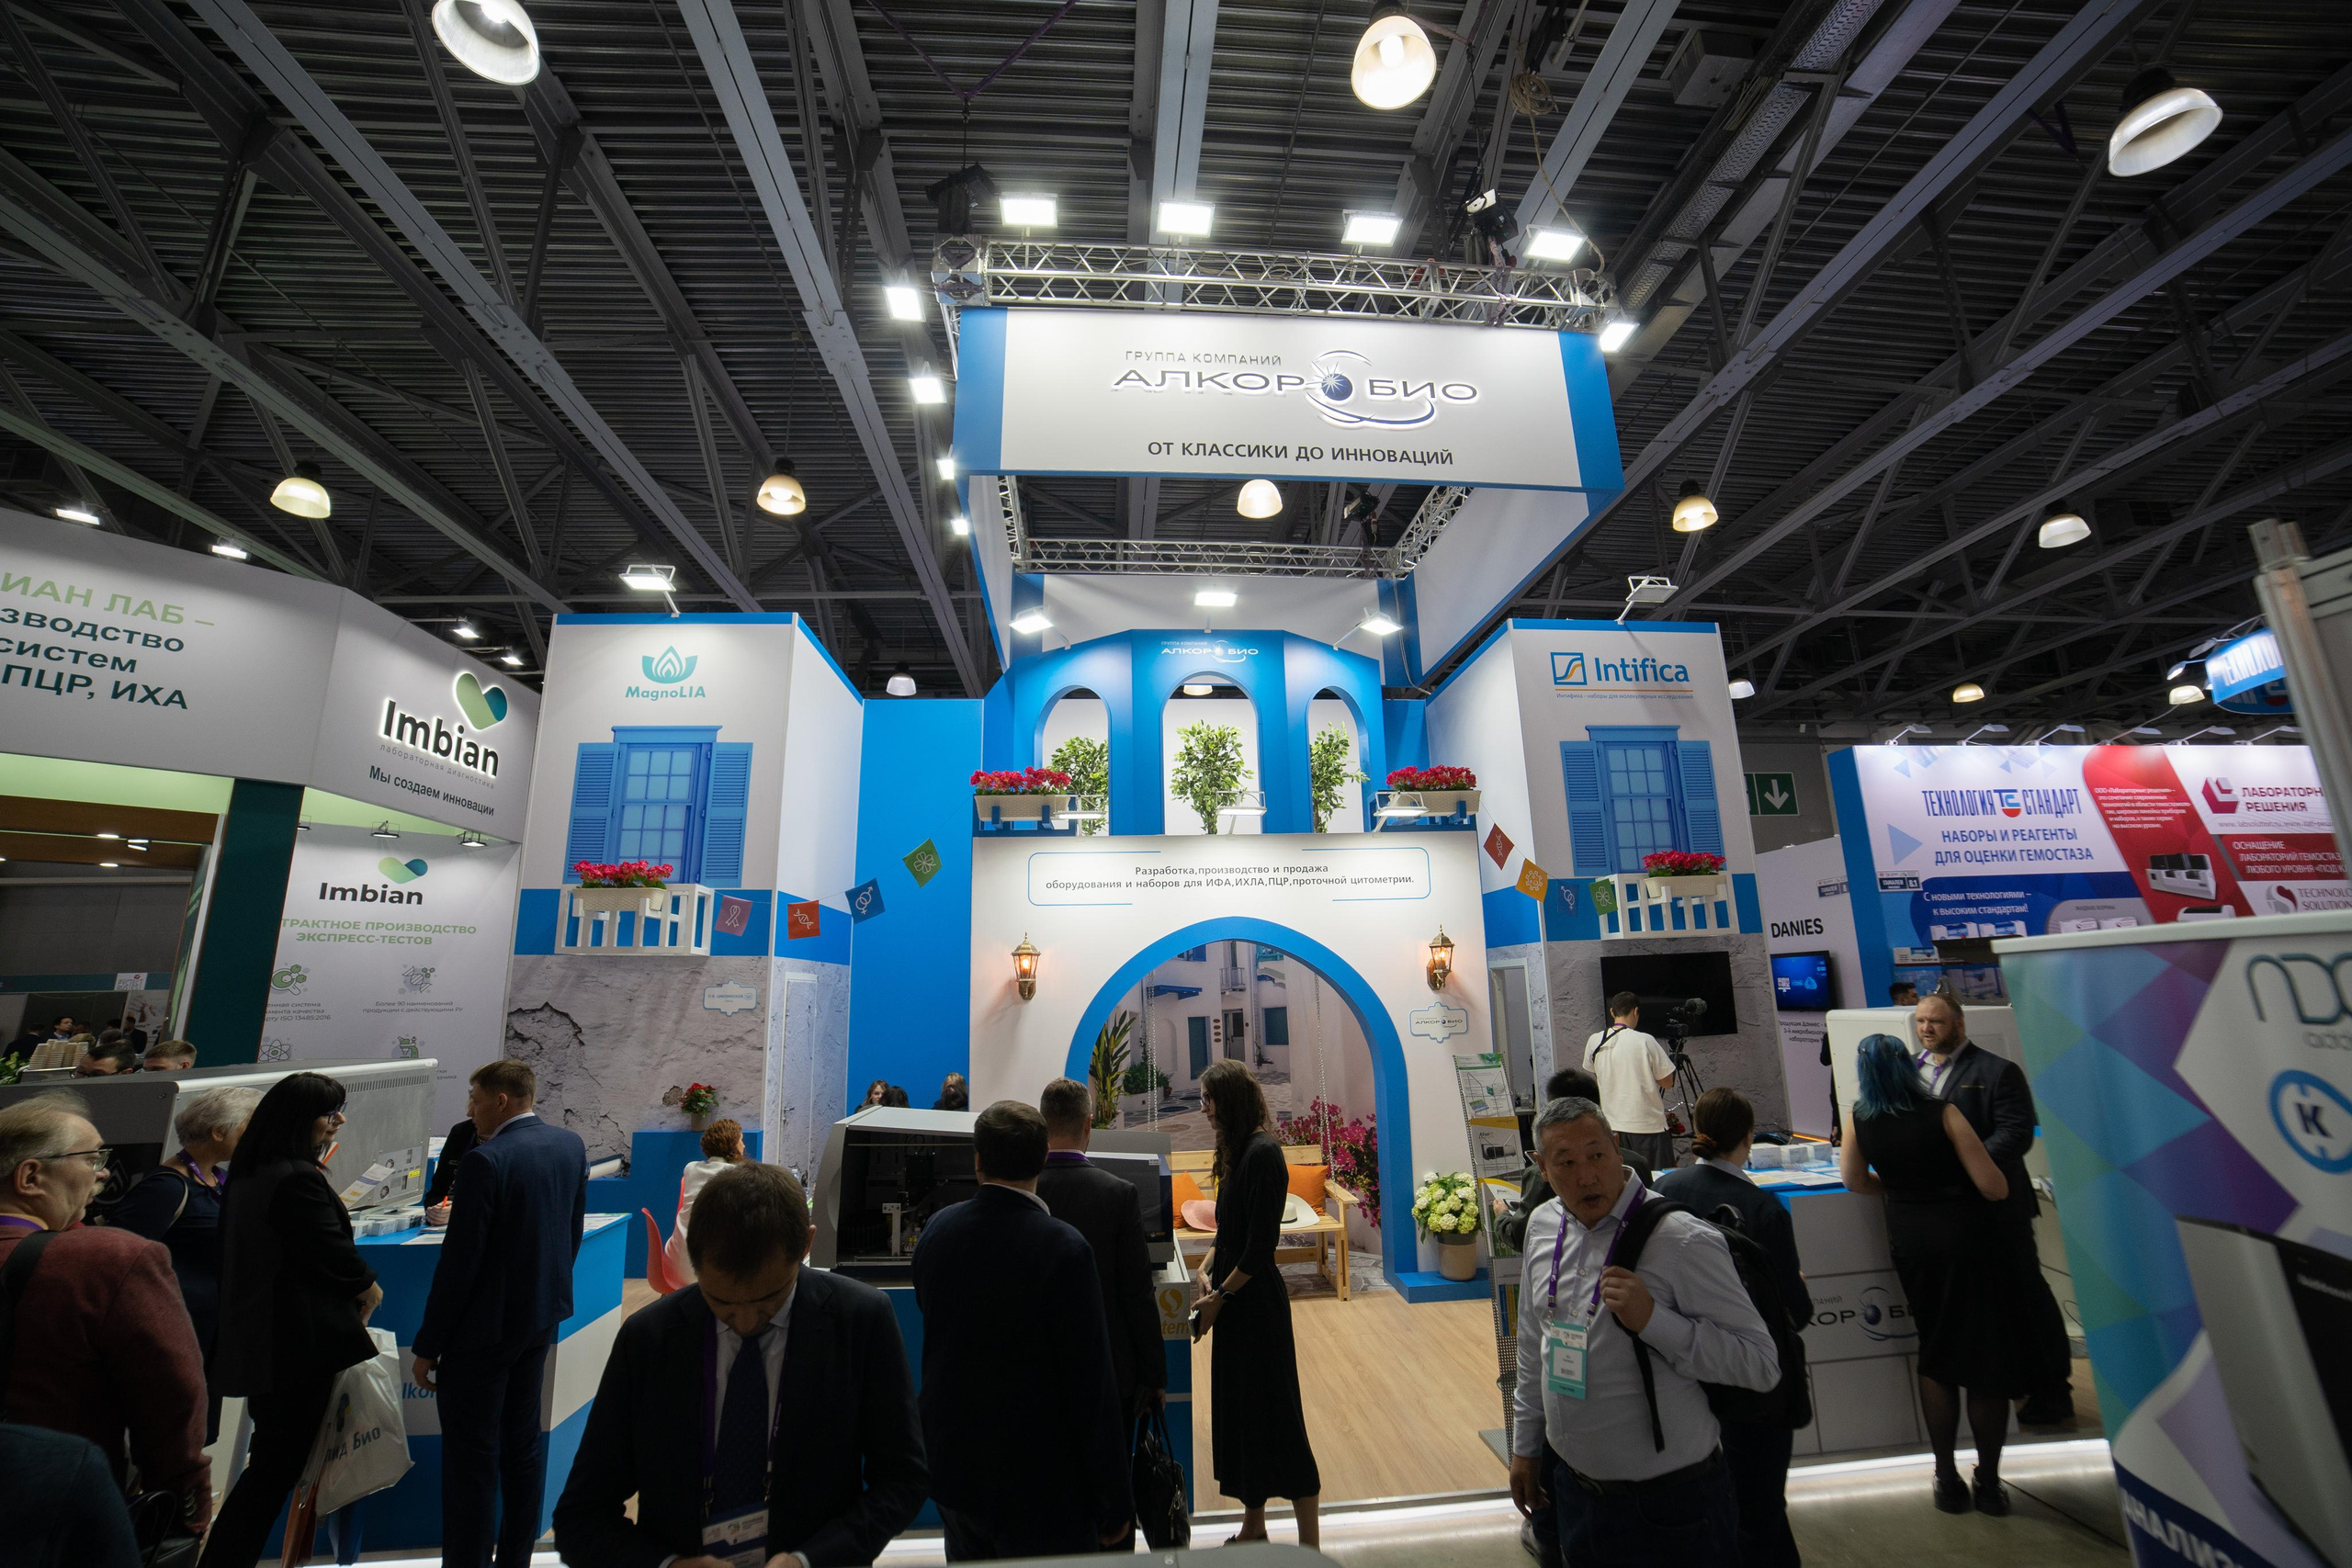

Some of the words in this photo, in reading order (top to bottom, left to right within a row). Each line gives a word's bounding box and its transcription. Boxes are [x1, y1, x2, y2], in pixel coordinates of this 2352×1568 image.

[1125, 350, 1186, 364] ГРУППА
[1193, 353, 1282, 367] КОМПАНИЙ
[1113, 368, 1306, 391] АЛКОР
[1368, 378, 1478, 400] БИО
[1148, 441, 1174, 456] ОТ
[1182, 442, 1288, 459] КЛАССИКИ
[1295, 446, 1324, 462] ДО
[1331, 447, 1454, 467] ИННОВАЦИЙ
[103, 592, 185, 626] ЛАБ
[1594, 657, 1690, 682] Intifica
[1, 663, 96, 700] ПЦР,
[110, 680, 188, 710] ИХА
[625, 685, 707, 702] MagnoLIA
[1555, 693, 1584, 701] Интифика
[1588, 693, 1607, 701] наборы
[1657, 693, 1694, 701] исследований
[381, 697, 500, 779] Imbian
[379, 742, 445, 773] лабораторная
[447, 767, 495, 791] диагностика
[369, 764, 391, 784] Мы
[393, 778, 441, 800] создаем
[442, 791, 495, 817] инновации
[1921, 789, 1997, 818] ТЕХНОЛОГИЯ
[2021, 788, 2083, 818] СТАНДАРТ
[2245, 801, 2309, 813] РЕШЕНИЯ
[1940, 829, 1997, 843] НАБОРЫ
[1999, 829, 2011, 842] И
[2013, 828, 2078, 842] РЕАГЕНТЫ
[2232, 840, 2287, 852] ОСНАЩЕНИЕ
[1934, 851, 1962, 866] ДЛЯ
[1964, 849, 2018, 865] ОЦЕНКИ
[2020, 847, 2095, 862] ГЕМОСТАЗА
[2239, 851, 2299, 863] ЛАБОРАТОРИЙ
[2300, 852, 2345, 862] ГЕМОСТАЗ
[1283, 864, 1329, 875] продажа
[2245, 864, 2281, 874] ЛЮБОГО
[2281, 864, 2315, 874] УРОВНЯ
[1046, 879, 1123, 891] оборудования
[1136, 878, 1181, 889] наборов
[1183, 879, 1203, 888] для
[1351, 875, 1414, 886] цитометрии.
[319, 882, 424, 906] Imbian
[1923, 891, 1931, 902] С
[1931, 892, 1966, 902] новыми
[1966, 890, 2025, 902] технологиями
[1939, 907, 1978, 916] высоким
[1978, 902, 2030, 916] стандартам!
[364, 920, 478, 935] ПРОИЗВОДСТВО
[1770, 917, 1825, 939] DANIES
[296, 931, 434, 946] ЭКСПРЕСС-ТЕСТОВ
[353, 1427, 382, 1451] Био
